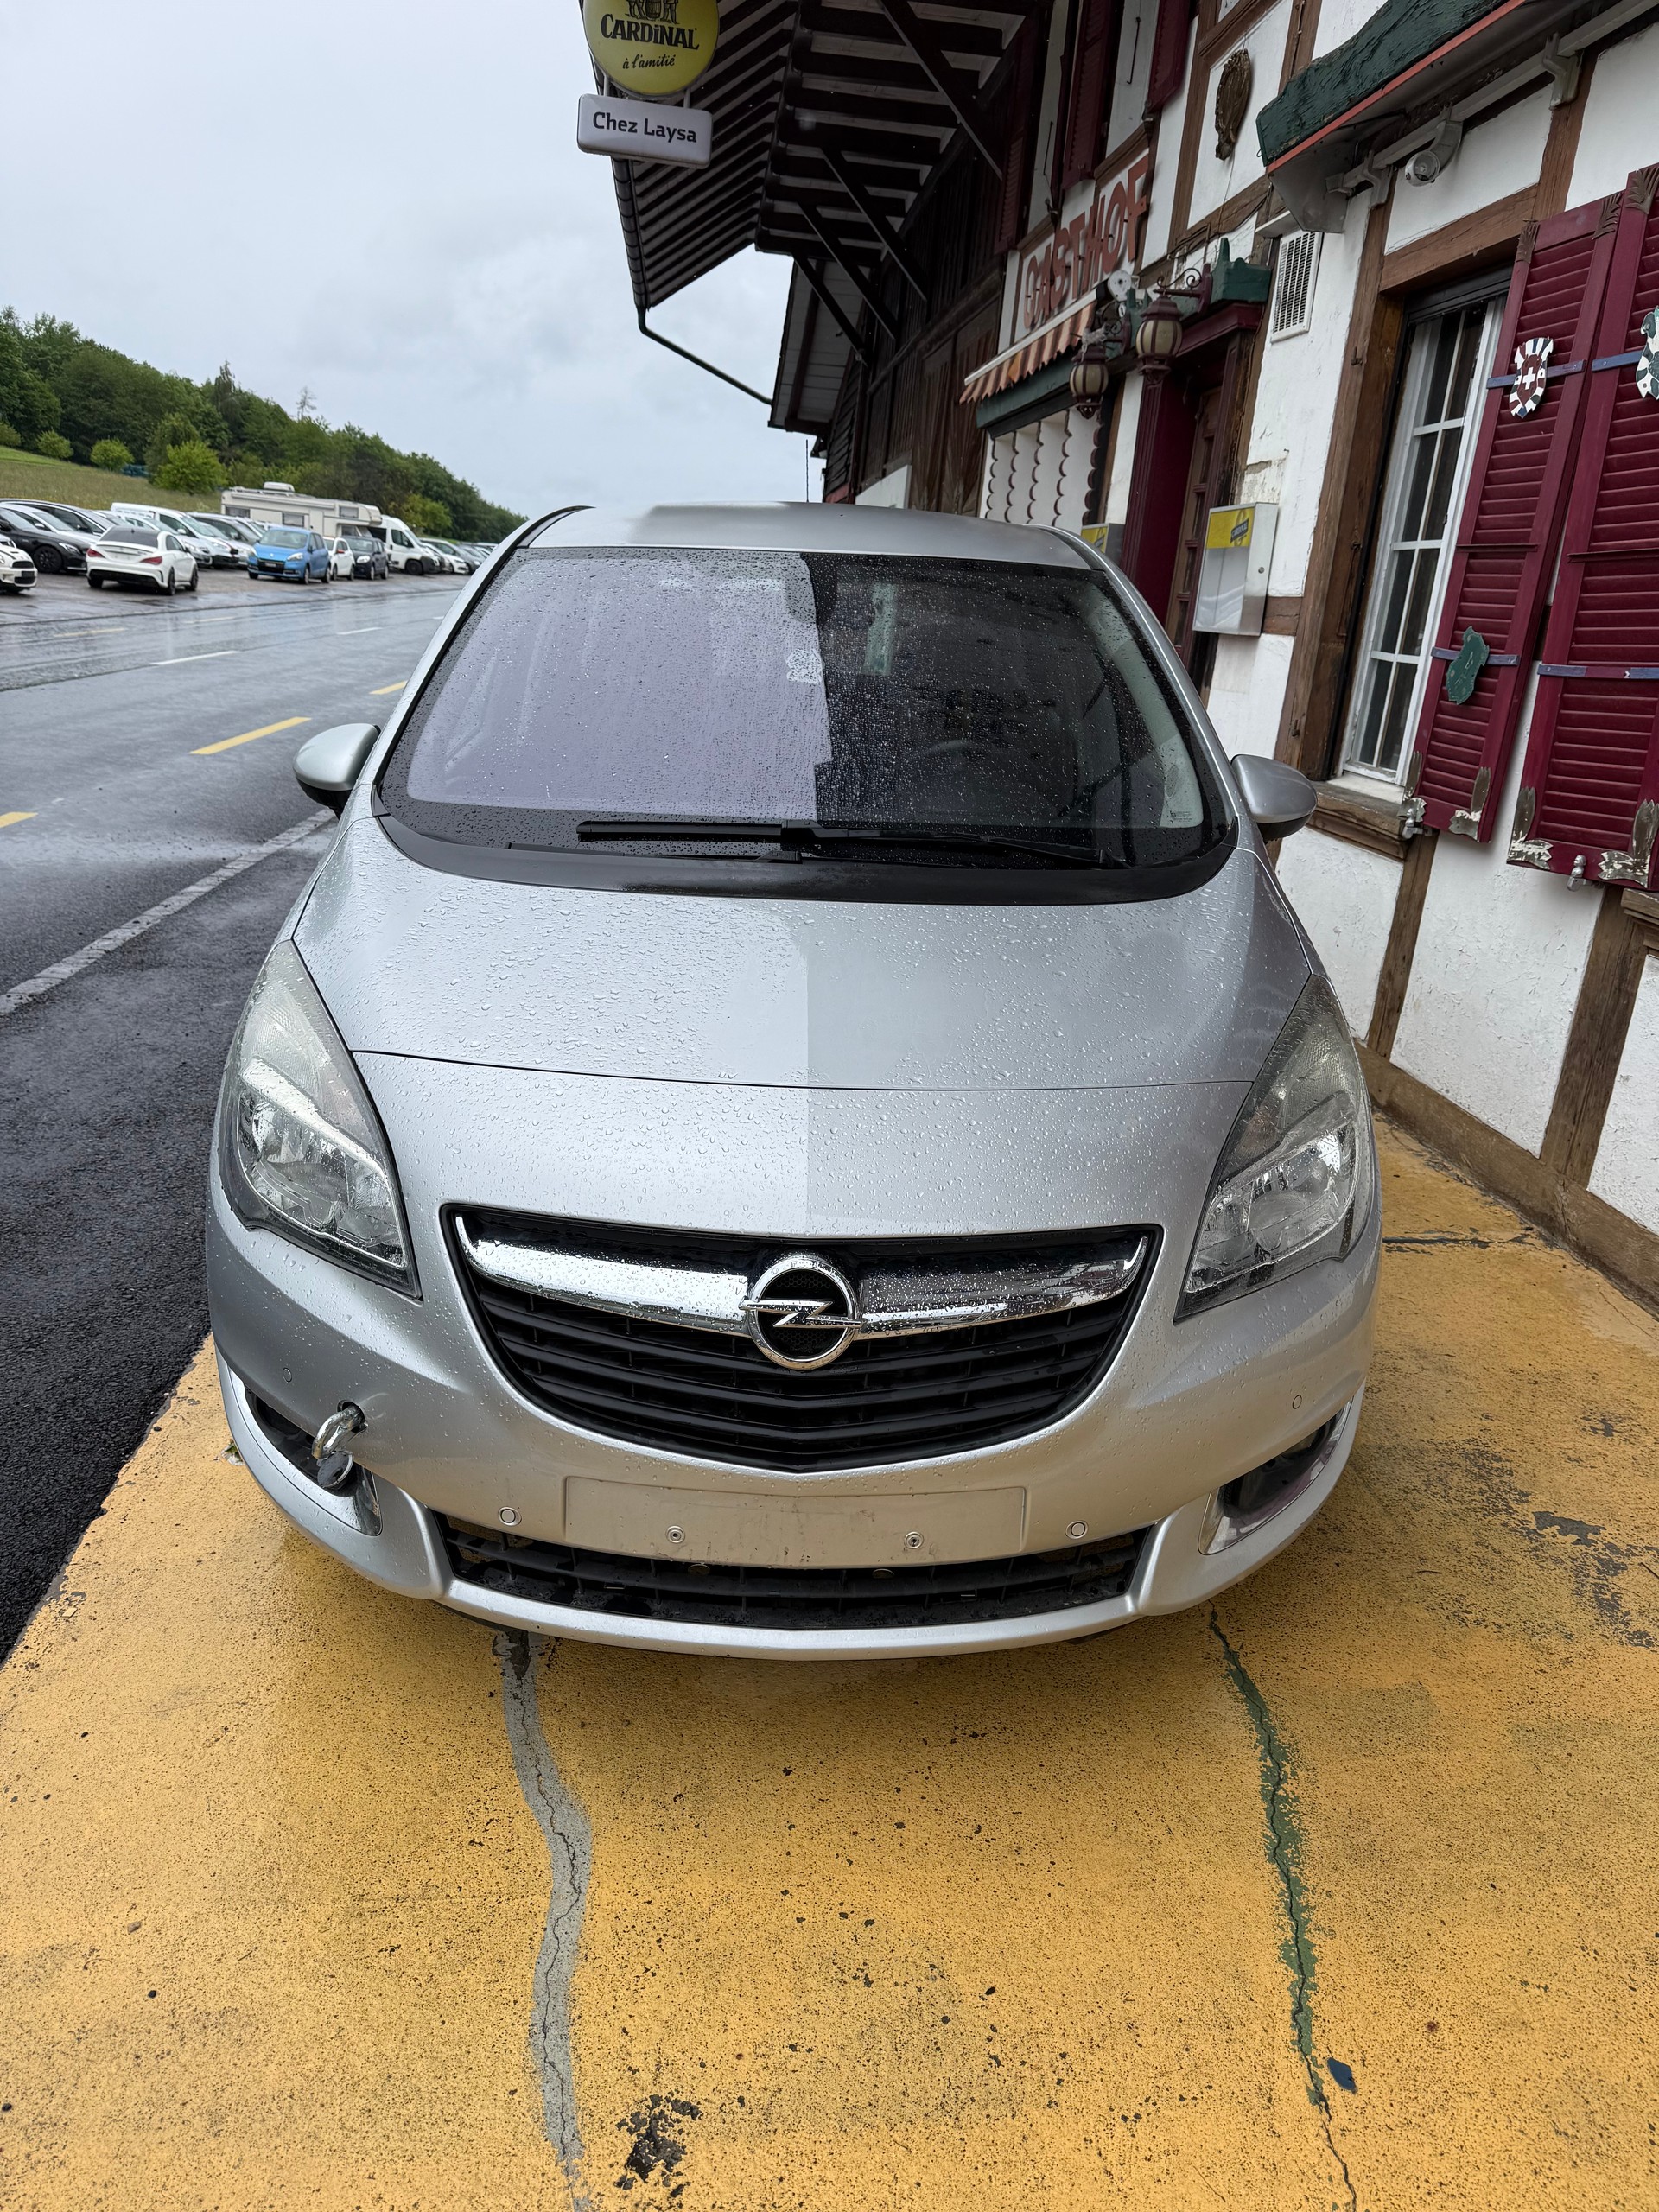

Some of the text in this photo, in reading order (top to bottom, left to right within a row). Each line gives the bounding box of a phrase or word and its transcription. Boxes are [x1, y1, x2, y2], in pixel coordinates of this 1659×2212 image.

[622, 54, 676, 69] à l'amitié
[593, 111, 697, 143] Chez Laysa
[1024, 154, 1148, 329] GASTHOF
